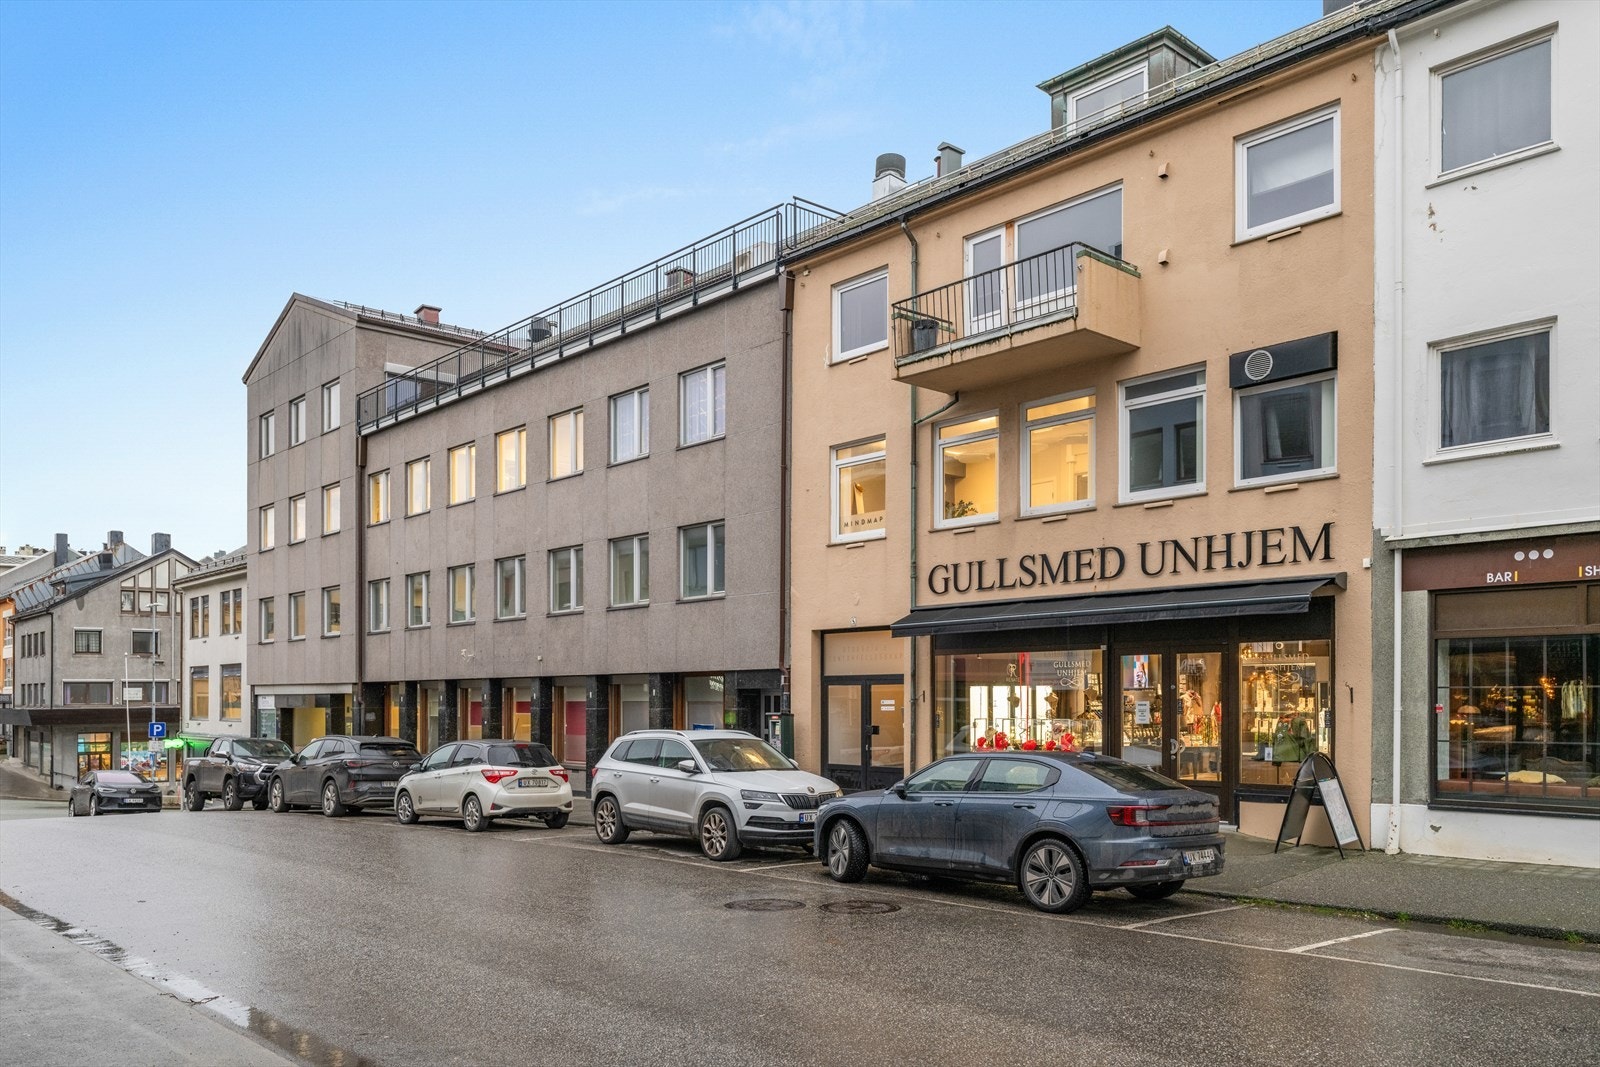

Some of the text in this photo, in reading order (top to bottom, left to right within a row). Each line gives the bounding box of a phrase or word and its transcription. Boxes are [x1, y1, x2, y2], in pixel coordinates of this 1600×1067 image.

[844, 516, 884, 528] MINDMAP
[928, 522, 1336, 595] GULLSMED UNHJEM
[1486, 571, 1513, 583] BAR
[1053, 660, 1092, 669] GULLSMED
[1056, 668, 1088, 678] UNHJEM
[153, 724, 163, 736] P
